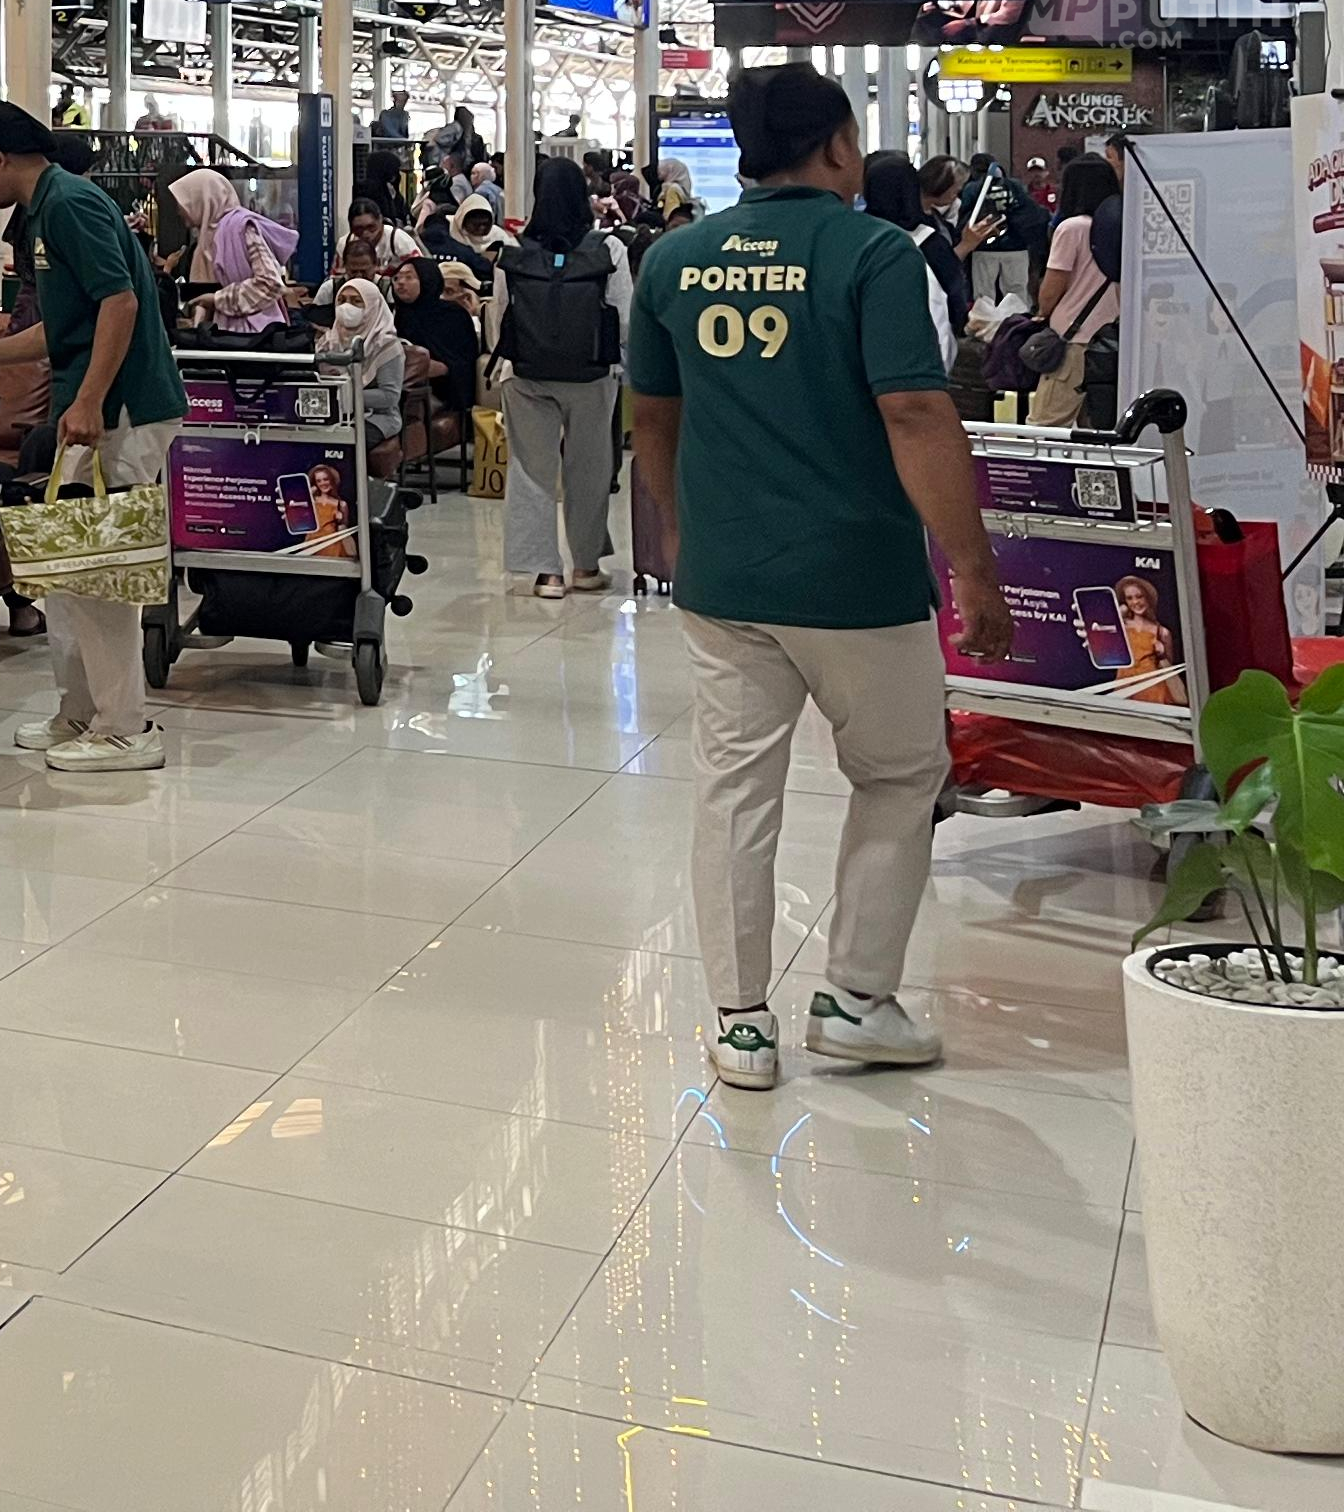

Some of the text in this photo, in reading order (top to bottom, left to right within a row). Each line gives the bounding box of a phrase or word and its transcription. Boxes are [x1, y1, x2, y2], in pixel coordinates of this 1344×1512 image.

[55, 12, 68, 22] 2
[1058, 93, 1123, 107] LOUNGE
[679, 265, 807, 292] PORTER
[697, 303, 789, 358] 09
[325, 450, 344, 459] KAI
[1135, 556, 1160, 570] KAI
[1004, 585, 1060, 599] Perjalanan
[1022, 598, 1048, 609] Asyik
[1034, 611, 1047, 622] by
[1049, 612, 1066, 622] KAI
